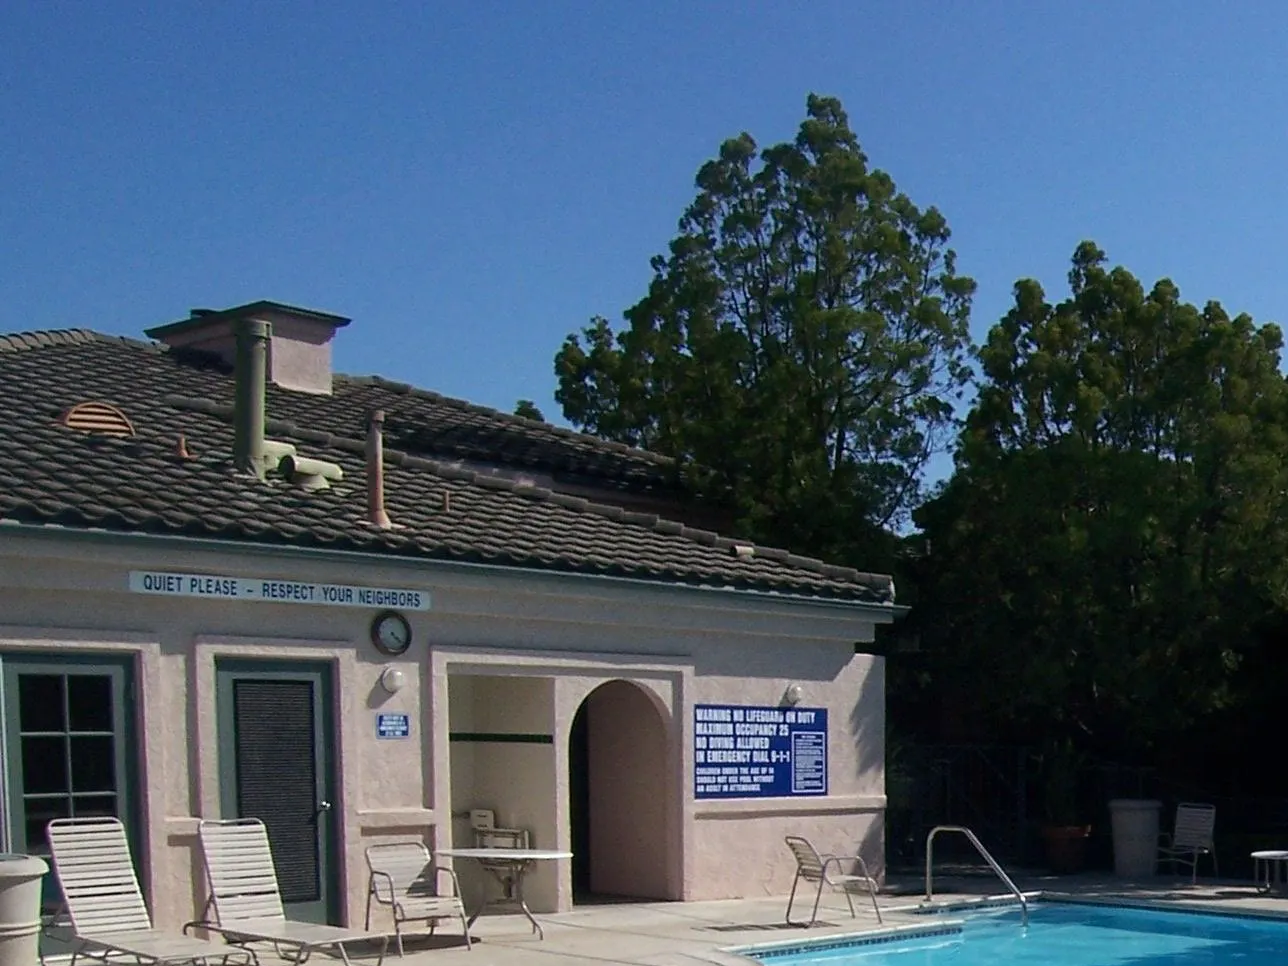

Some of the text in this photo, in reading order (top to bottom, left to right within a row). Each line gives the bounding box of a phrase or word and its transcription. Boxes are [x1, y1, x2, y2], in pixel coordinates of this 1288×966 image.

[144, 574, 182, 592] QUIET
[190, 578, 237, 595] PLEASE
[263, 583, 314, 600] RESPECT
[323, 587, 352, 602] YOUR
[359, 590, 420, 607] NEIGHBORS
[696, 709, 815, 723] WARNING NO LIFEGUARD ON DUTY
[696, 723, 789, 736] MAXIMUM OCCUPANCY 25
[696, 737, 769, 749] NO DIVING ALLOWED
[696, 750, 790, 762] IN EMERGENCY DIAL 9-1-1
